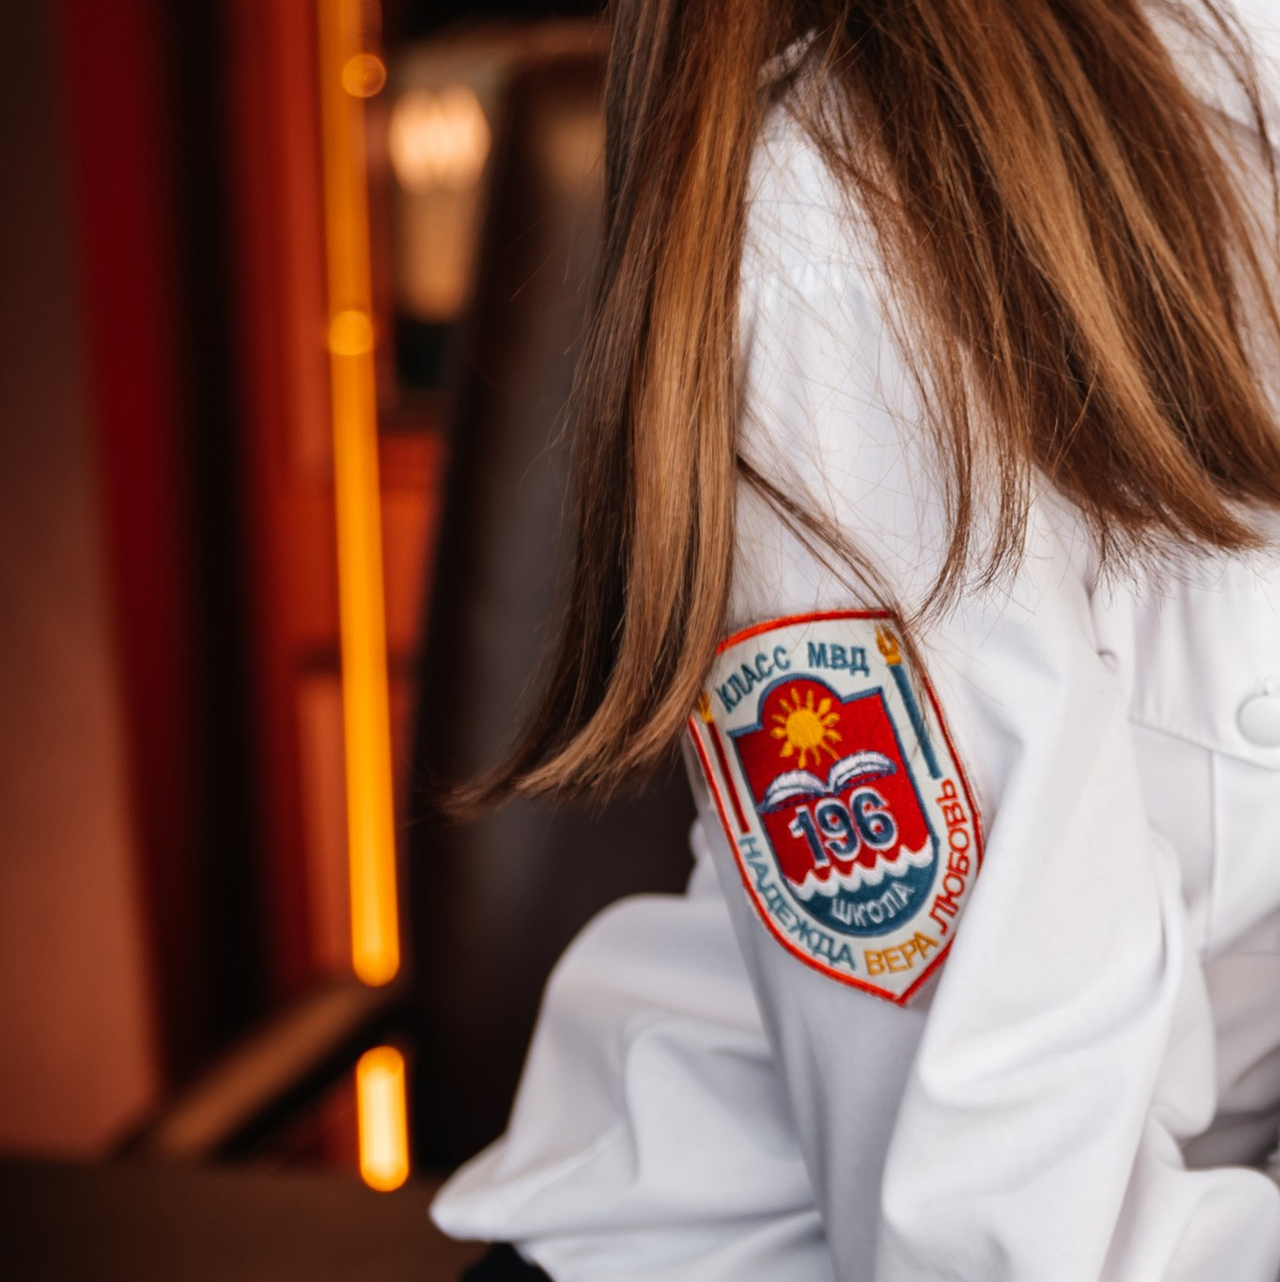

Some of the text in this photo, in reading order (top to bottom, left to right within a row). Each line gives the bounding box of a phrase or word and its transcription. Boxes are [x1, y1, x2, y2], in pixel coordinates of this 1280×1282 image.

[715, 642, 870, 714] КЛАСС МВД
[789, 786, 897, 869] 196
[739, 778, 971, 976] НАДЕЖДА ВЕРА ЛЮБОВЬ
[832, 883, 915, 927] ШКОЛА
